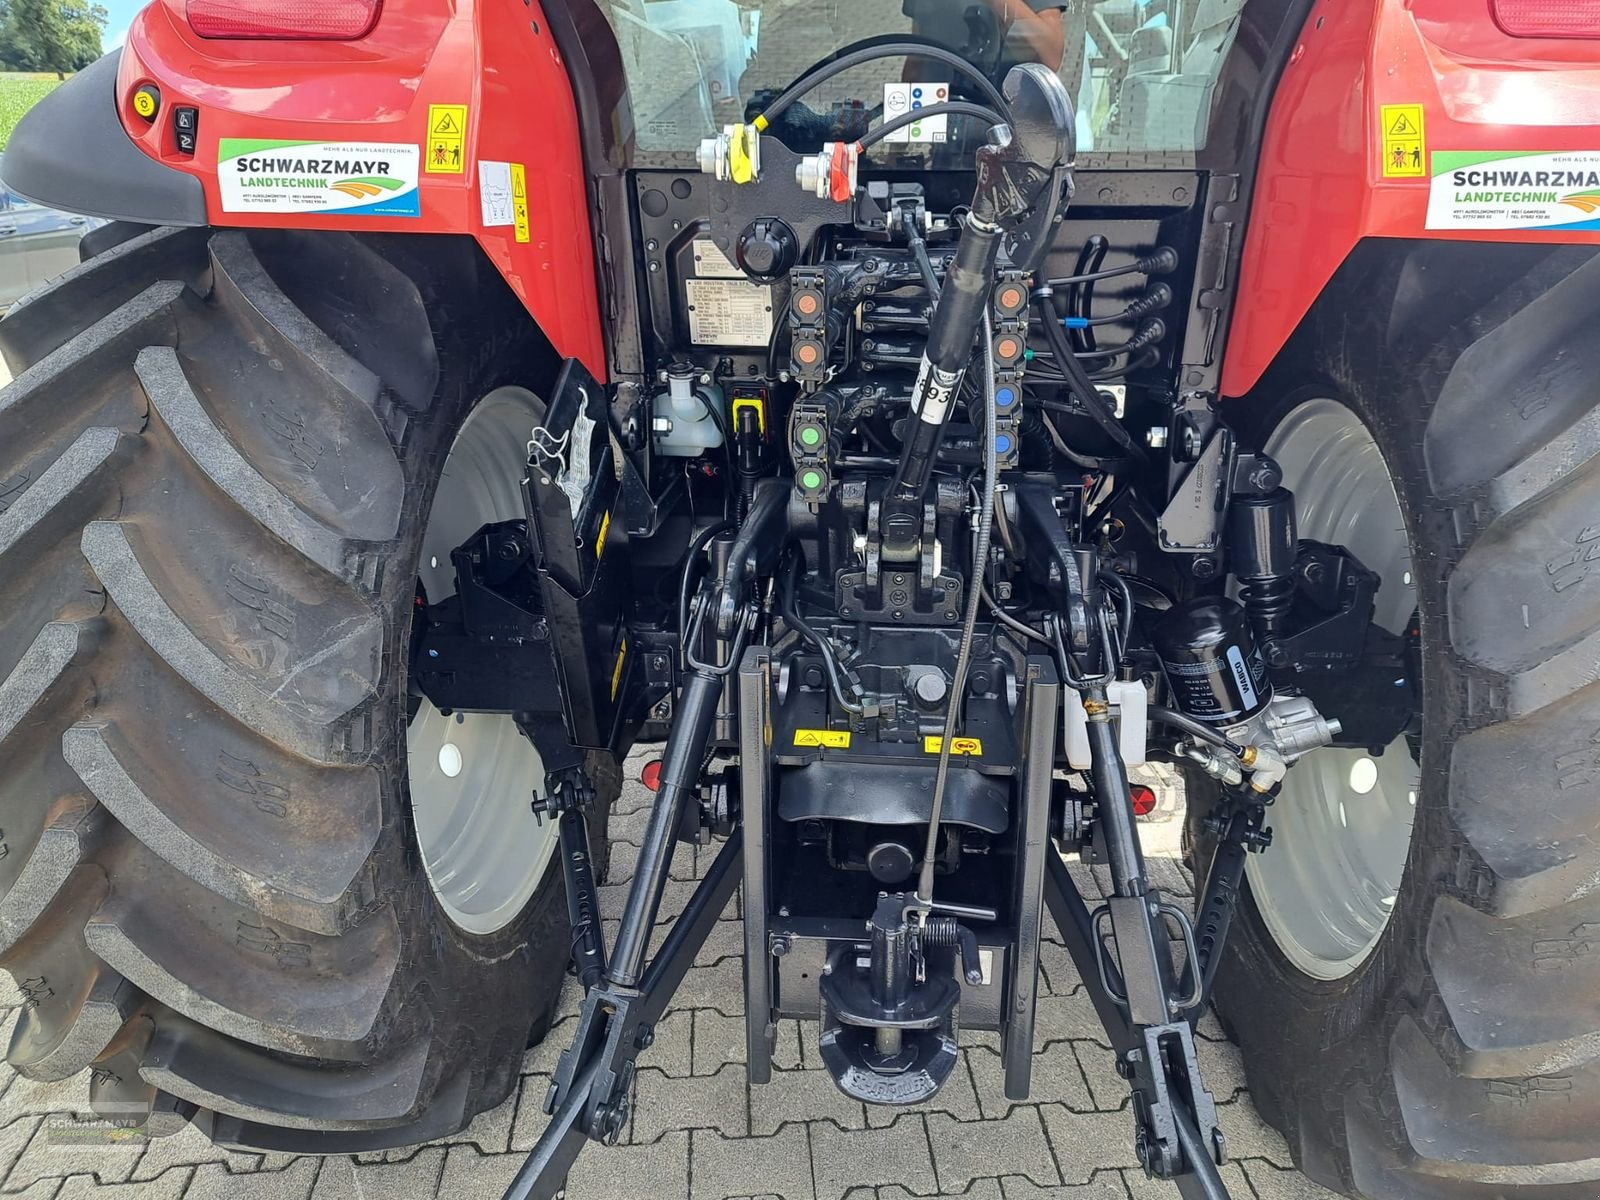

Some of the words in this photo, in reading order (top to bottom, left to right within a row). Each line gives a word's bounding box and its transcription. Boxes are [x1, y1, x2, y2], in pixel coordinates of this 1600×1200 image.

[236, 158, 390, 175] SCHWARZMAYR
[240, 177, 329, 189] LANDTECHNIK
[1453, 171, 1600, 187] SCHWARZMA
[1454, 191, 1557, 203] LANDTECHNIK
[1234, 661, 1250, 694] WABCO
